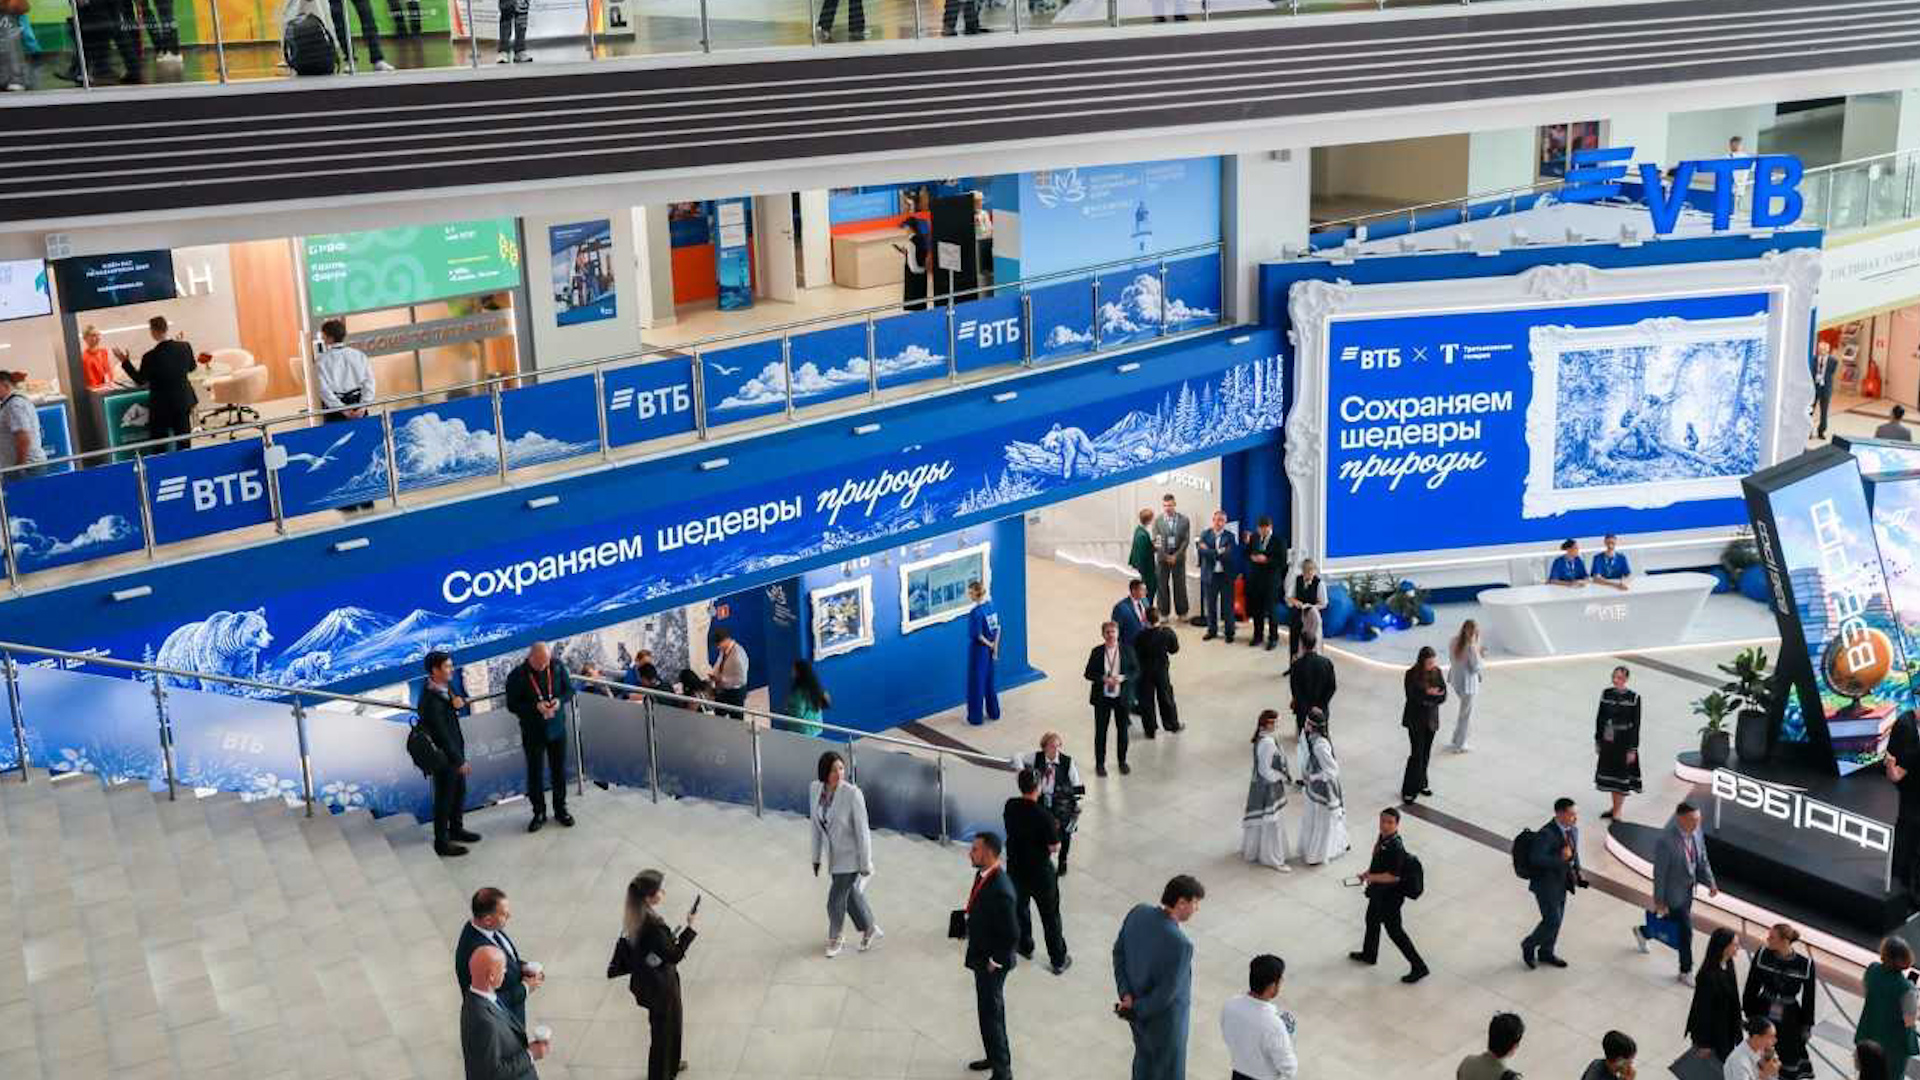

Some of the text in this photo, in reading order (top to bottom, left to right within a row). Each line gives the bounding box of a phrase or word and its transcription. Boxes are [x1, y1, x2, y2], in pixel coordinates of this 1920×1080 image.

[1638, 154, 1805, 234] VTB
[978, 316, 1020, 351] ВТБ
[1360, 347, 1402, 369] ВТБ
[637, 382, 690, 420] ВТБ
[1340, 390, 1514, 425] Сохраняем
[1340, 419, 1482, 451] шедевры
[192, 469, 263, 512] ВТБ
[1338, 450, 1488, 494] природы
[442, 456, 956, 605] Сохраняем шедевры природы
